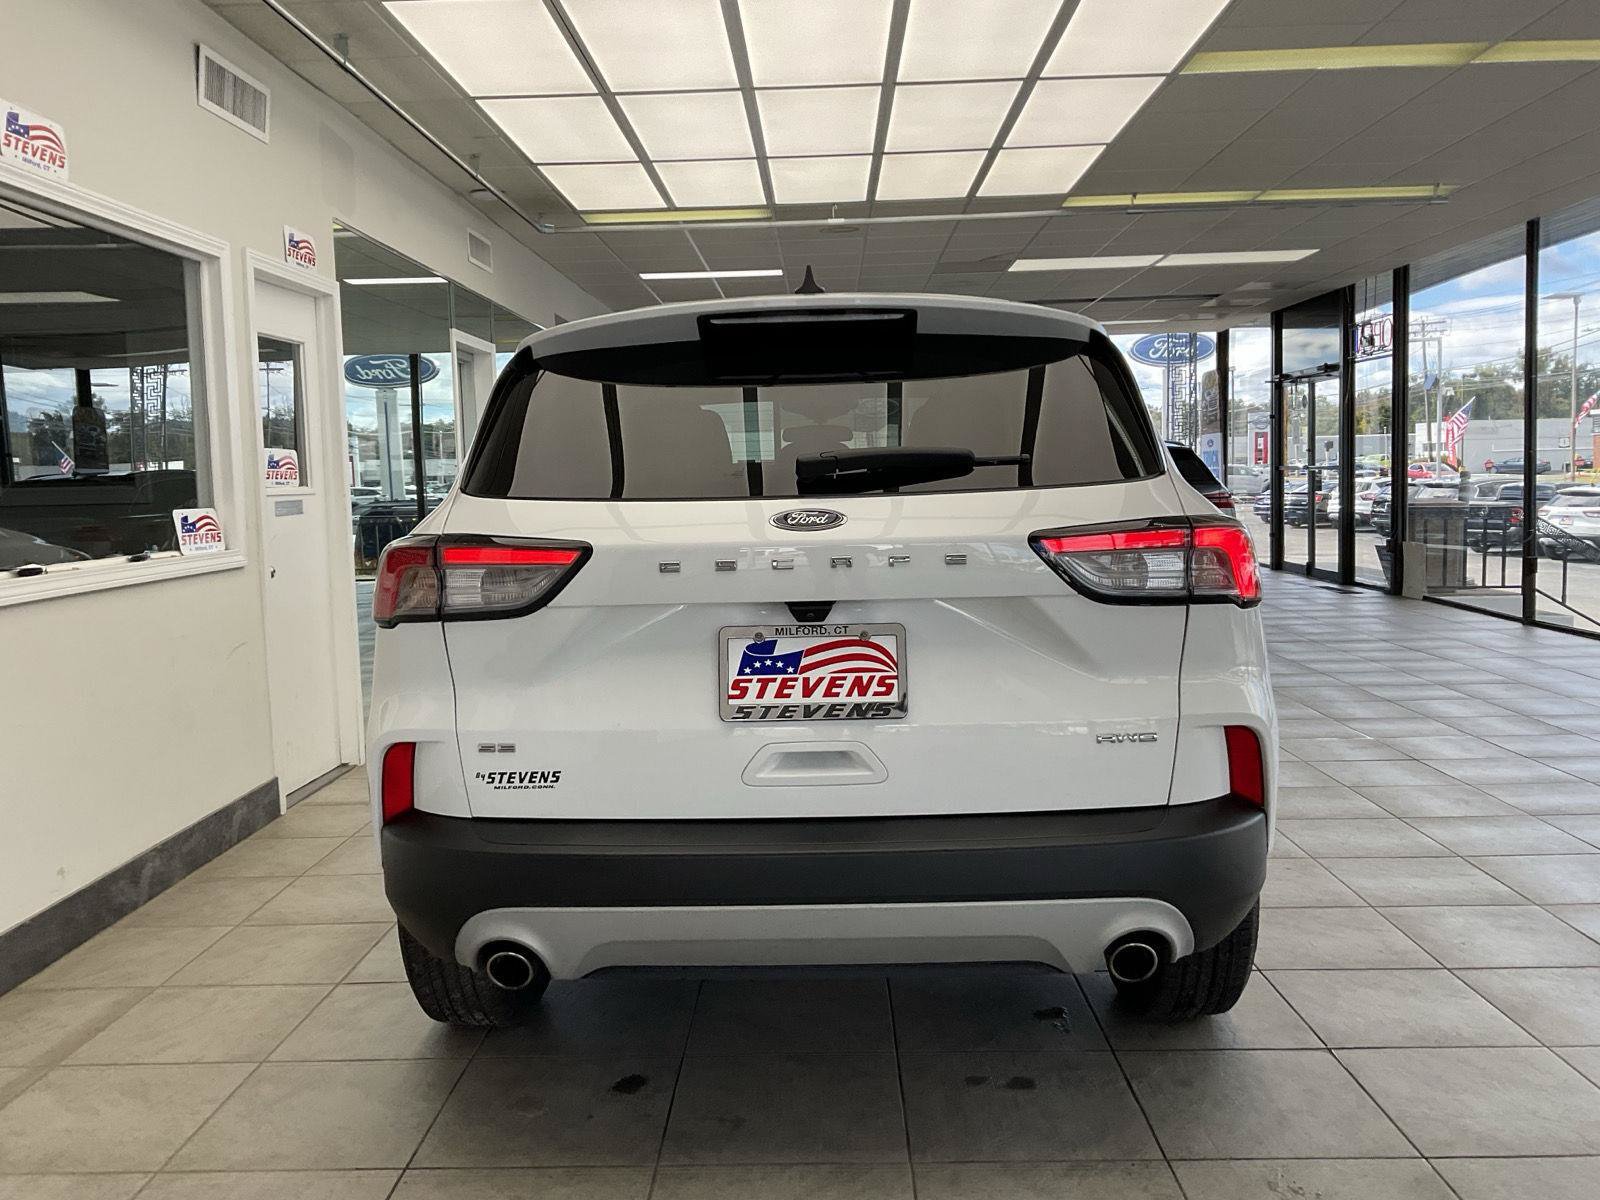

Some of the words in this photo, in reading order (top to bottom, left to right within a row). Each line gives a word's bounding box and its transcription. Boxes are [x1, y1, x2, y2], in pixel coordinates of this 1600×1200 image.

[2, 132, 66, 169] STEVENS
[287, 247, 316, 267] STEVENS
[265, 470, 298, 480] STEVENS
[787, 511, 829, 524] Ford
[181, 532, 222, 546] STEVENS
[659, 552, 967, 573] ESCAPE
[774, 626, 831, 636] MILFORD,
[834, 625, 849, 635] CT
[728, 674, 898, 700] STEVENS
[731, 702, 896, 720] STEVENS
[1096, 731, 1157, 744] AWD
[486, 770, 562, 784] STEVENS
